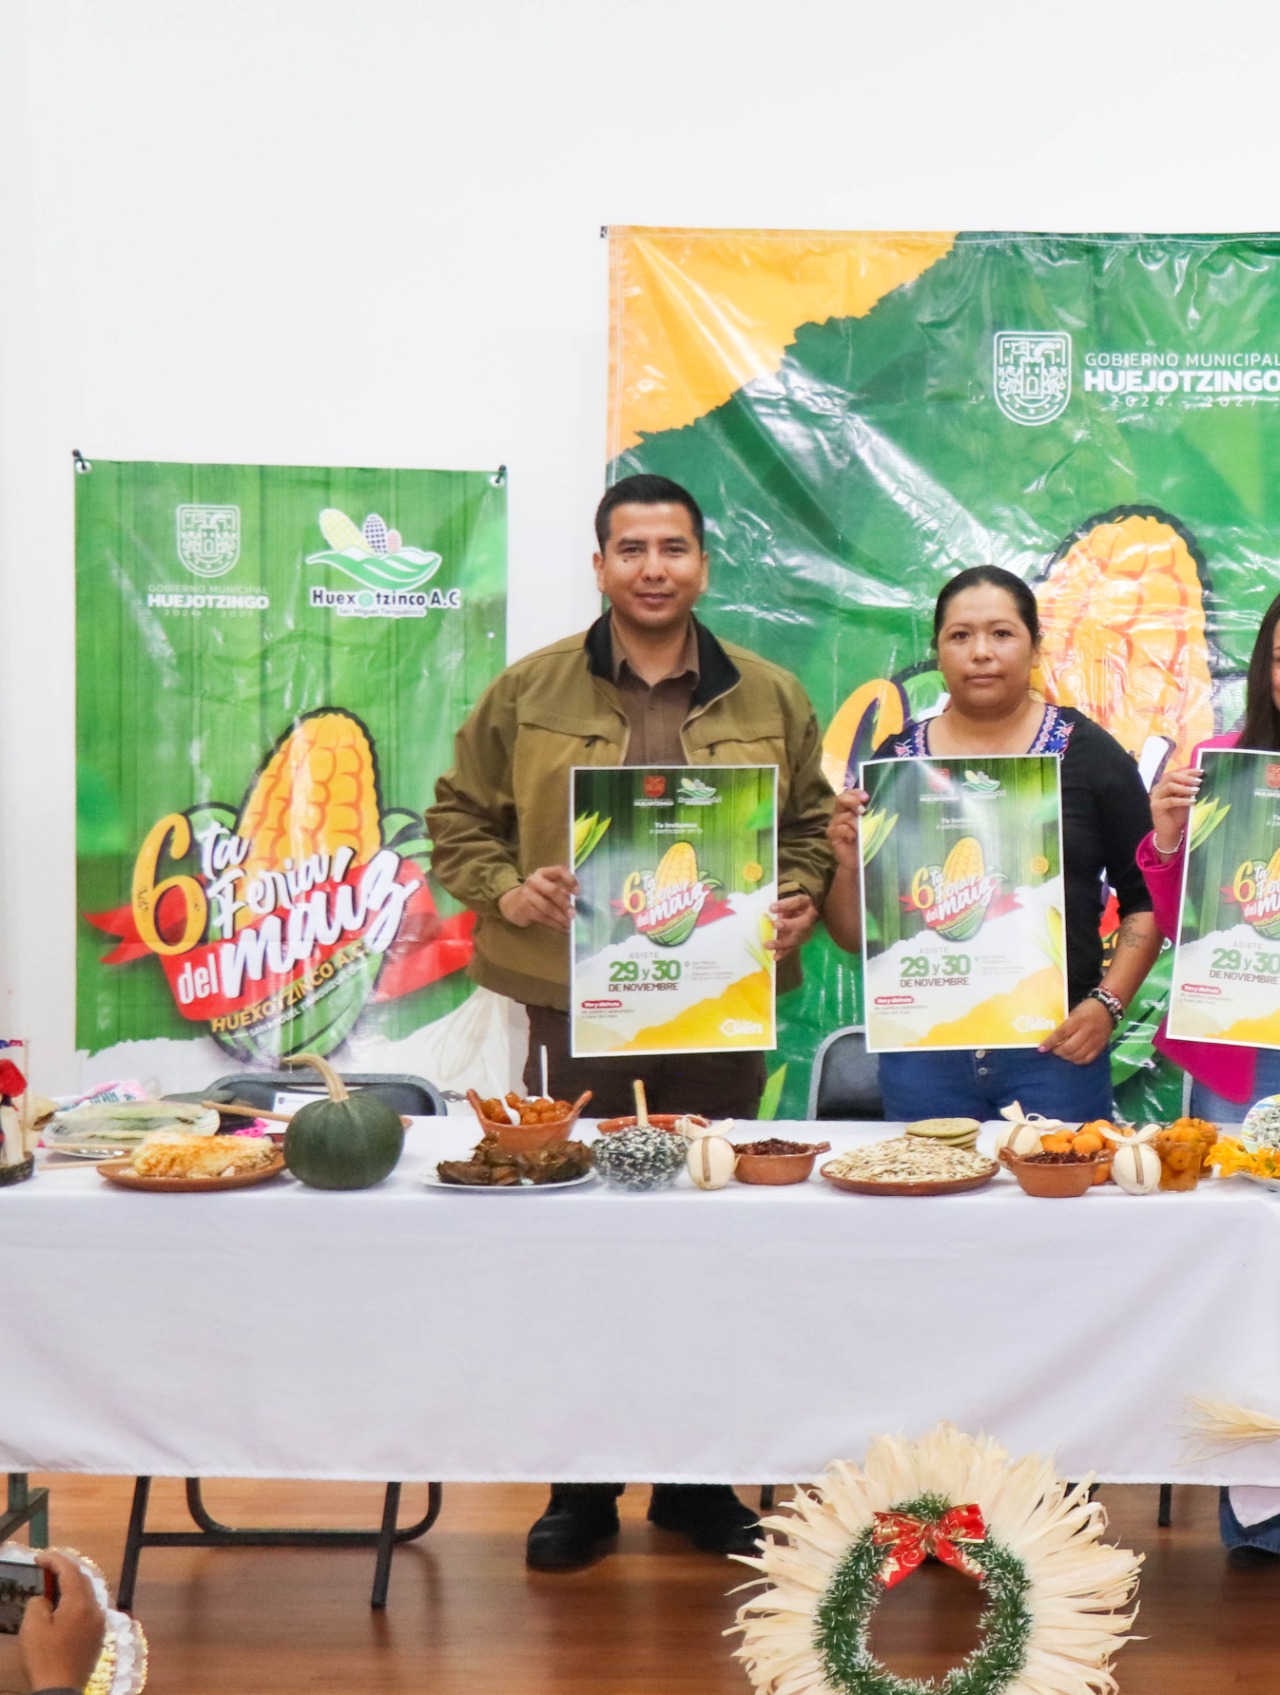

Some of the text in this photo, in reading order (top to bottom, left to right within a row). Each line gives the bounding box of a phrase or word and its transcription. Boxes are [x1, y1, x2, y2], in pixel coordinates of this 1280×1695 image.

[1085, 353, 1179, 367] GOBIERNO
[1110, 396, 1165, 408] 2024
[149, 584, 267, 596] GOBIERNO MUNICIPAL
[148, 594, 269, 609] HUEJOTZINGO
[207, 853, 330, 939] Feria
[925, 906, 939, 922] del
[1244, 902, 1257, 917] del
[636, 911, 649, 927] del
[1232, 941, 1263, 950] ASISTE
[900, 955, 971, 978] 29 y 30
[1211, 948, 1241, 971] 29
[1243, 957, 1251, 971] y
[177, 953, 218, 1005] del
[609, 960, 639, 983] 29
[642, 966, 649, 980] y
[651, 959, 681, 981] 30
[1209, 969, 1222, 980] DE
[1224, 971, 1279, 985] NOVIEMBRE
[608, 983, 679, 992] DE NOVIEMBRE
[900, 977, 969, 988] DE NOVIEMBRE
[211, 962, 334, 1033] HUEXOTZINCO
